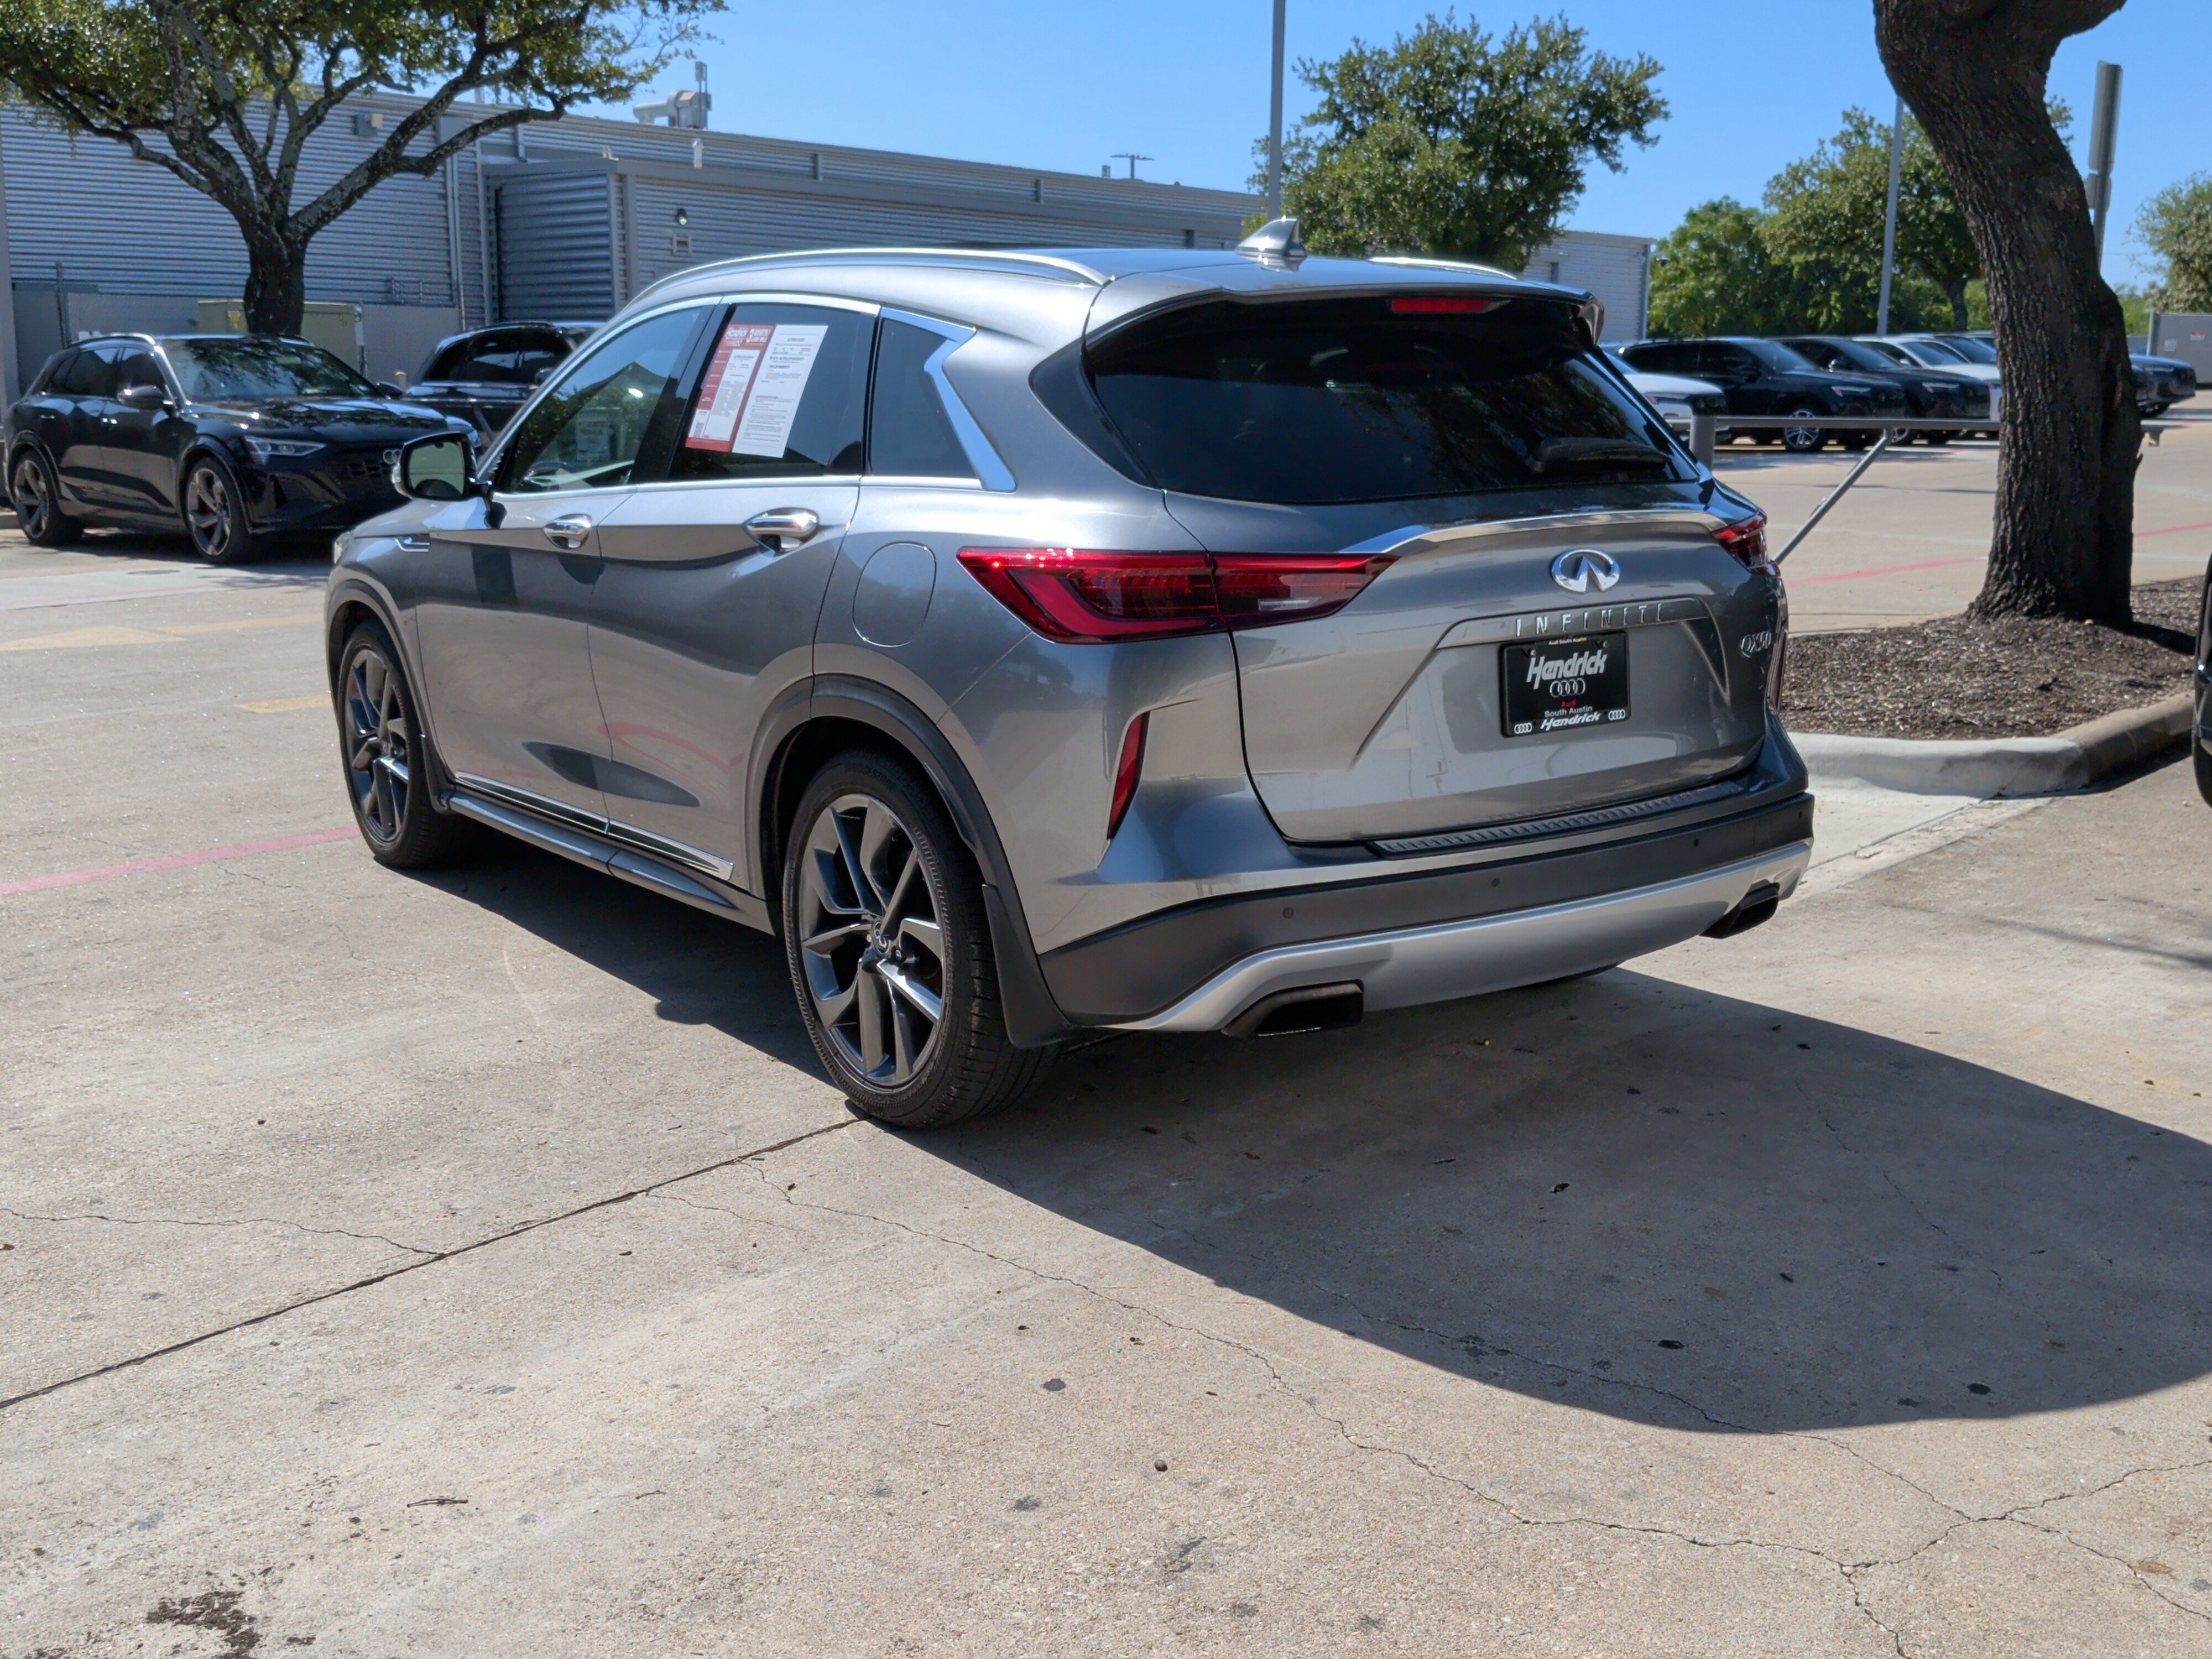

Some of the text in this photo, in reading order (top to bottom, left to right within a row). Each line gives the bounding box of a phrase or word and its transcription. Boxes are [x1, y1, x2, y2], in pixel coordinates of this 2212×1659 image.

[1516, 603, 1661, 637] INFINITI
[1740, 629, 1772, 658] QX50
[1526, 649, 1608, 690] Hendrick
[1544, 705, 1593, 718] South Austin
[1561, 700, 1577, 708] Audi
[1540, 711, 1601, 732] Hendrick
